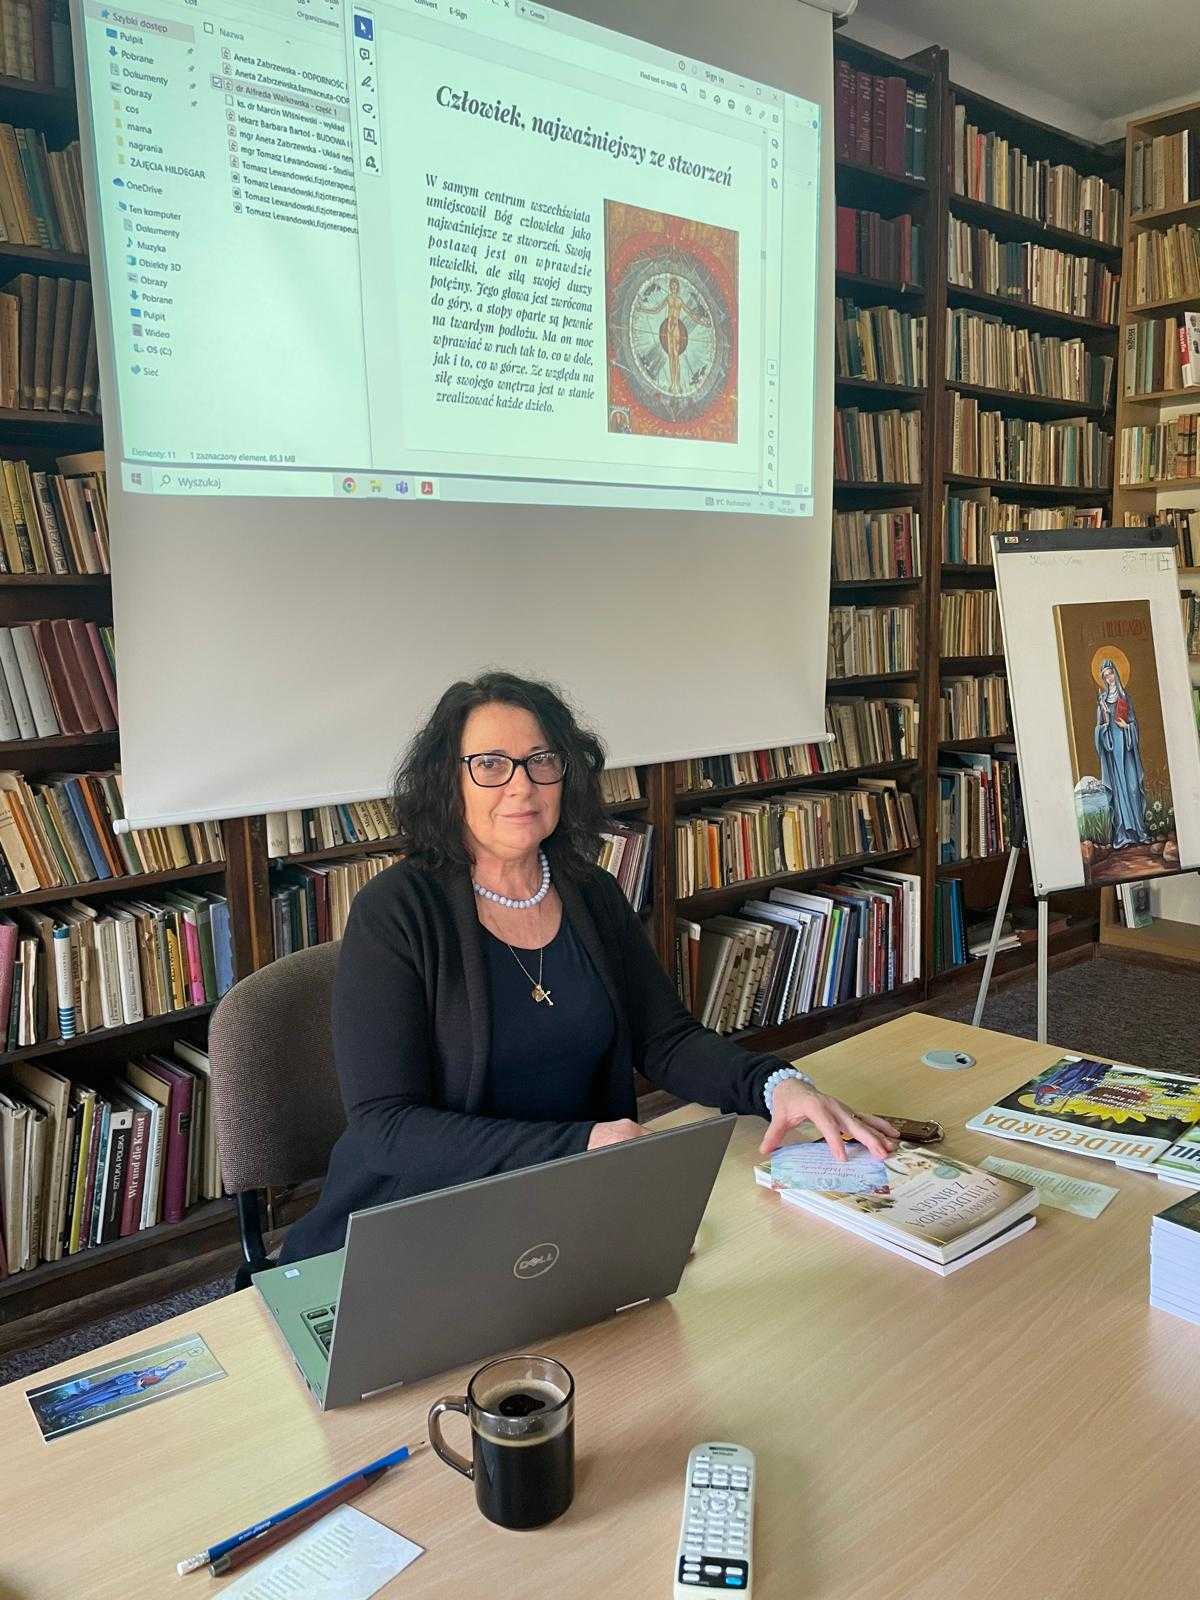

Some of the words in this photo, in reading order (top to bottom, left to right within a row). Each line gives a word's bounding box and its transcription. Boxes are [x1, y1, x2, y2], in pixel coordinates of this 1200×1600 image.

[112, 12, 138, 26] Szybki
[120, 32, 143, 44] Pulpit
[220, 28, 244, 40] Nazwa
[121, 50, 154, 64] Pobrane
[234, 54, 255, 66] Aneta
[256, 58, 296, 76] Zabrzewska
[122, 68, 168, 87] Dokumenty
[235, 69, 256, 81] Aneta
[705, 70, 718, 83] Sign
[719, 76, 725, 85] in
[124, 86, 152, 101] Obrazy
[236, 85, 244, 93] dr
[245, 87, 272, 100] Alfreda
[256, 104, 280, 116] Marcin
[127, 123, 152, 134] mama
[238, 115, 259, 127] lekarz
[260, 119, 288, 133] Barbara
[316, 132, 346, 147] BUDOWA
[436, 85, 526, 131] Człowiek,
[532, 116, 646, 165] najważniejszy
[650, 150, 666, 167] ze
[668, 156, 732, 186] stworzeń
[129, 140, 163, 154] nagrania
[240, 131, 254, 140] mgr
[255, 134, 276, 145] Aneta
[277, 138, 316, 154] Zabrzewska
[240, 146, 255, 156] mgr
[256, 148, 282, 162] Tomasz
[283, 155, 328, 172] Lewandowski
[130, 157, 163, 172] ZAJĘCIA
[165, 164, 206, 180] HILDEGAR
[242, 161, 268, 175] Tomasz
[126, 181, 163, 195] OneDrive
[243, 176, 269, 189] Tomasz
[245, 191, 270, 203] Tomasz
[425, 173, 438, 187] W
[442, 180, 479, 197] samym
[484, 190, 525, 208] centrum
[530, 200, 591, 223] wszechświata
[130, 205, 142, 215] Ten
[144, 208, 181, 221] komputer
[246, 206, 271, 218] Tomasz
[426, 196, 486, 218] umiejscowił
[494, 209, 513, 225] Bóg
[520, 215, 564, 235] człowieka
[571, 226, 591, 240] jako
[136, 223, 180, 239] Dokumenty
[427, 216, 497, 239] najważniejsze
[502, 231, 512, 243] ze
[517, 234, 560, 252] stworzeń.
[565, 243, 591, 261] Swoją
[137, 241, 166, 253] Muzyka
[428, 235, 477, 256] postawą
[484, 246, 506, 260] jest
[514, 254, 527, 264] on
[535, 257, 592, 277] wprawdzie
[139, 258, 168, 271] Obiekty
[170, 263, 181, 272] 3D
[140, 276, 168, 289] Obrazy
[486, 265, 500, 278] ale
[508, 269, 525, 285] siłą
[533, 276, 561, 290] swojej
[567, 280, 592, 296] duszy
[142, 293, 173, 305] Pobrane
[430, 275, 472, 293] potężny.
[476, 281, 498, 297] Jego
[501, 286, 530, 302] głowa
[531, 292, 548, 305] jest
[550, 296, 592, 312] zwrócona
[144, 311, 166, 322] Pulpit
[431, 293, 444, 306] do
[486, 304, 512, 318] stopy
[516, 309, 546, 323] oparte
[549, 314, 559, 327] są
[562, 316, 594, 330] pewnie
[144, 328, 170, 339] Wideo
[432, 315, 445, 326] na
[450, 316, 494, 334] twardym
[498, 324, 538, 340] podłożu.
[542, 329, 557, 342] Ma
[560, 334, 572, 344] on
[576, 338, 594, 348] moc
[146, 346, 158, 354] OS
[433, 334, 482, 351] wprawiać
[484, 344, 493, 352] w
[495, 343, 518, 355] ruch
[520, 346, 535, 357] tak
[551, 352, 561, 361] co
[564, 354, 571, 362] w
[433, 351, 450, 366] jak
[453, 354, 457, 366] i
[476, 359, 486, 368] co
[490, 362, 498, 371] w
[545, 368, 580, 381] względu
[583, 373, 594, 383] na
[435, 371, 452, 386] siłę
[456, 375, 493, 390] swojego
[497, 379, 535, 394] wnętrza
[537, 381, 554, 396] jest
[557, 387, 565, 395] w
[569, 387, 595, 399] stanie
[436, 391, 495, 407] zrealizować
[496, 396, 523, 410] każde
[525, 399, 554, 413] dzieło.
[167, 451, 176, 459] 11
[196, 453, 237, 462] zaznaczony
[178, 477, 221, 490] Wyszukaj
[135, 1117, 145, 1144] Kunst
[982, 1112, 1154, 1160] HILDEGARDA
[132, 1146, 142, 1160] die
[132, 1162, 140, 1178] und
[953, 1181, 968, 1189] Z
[910, 1188, 957, 1211] BINGEN
[519, 1253, 552, 1270] DELL
